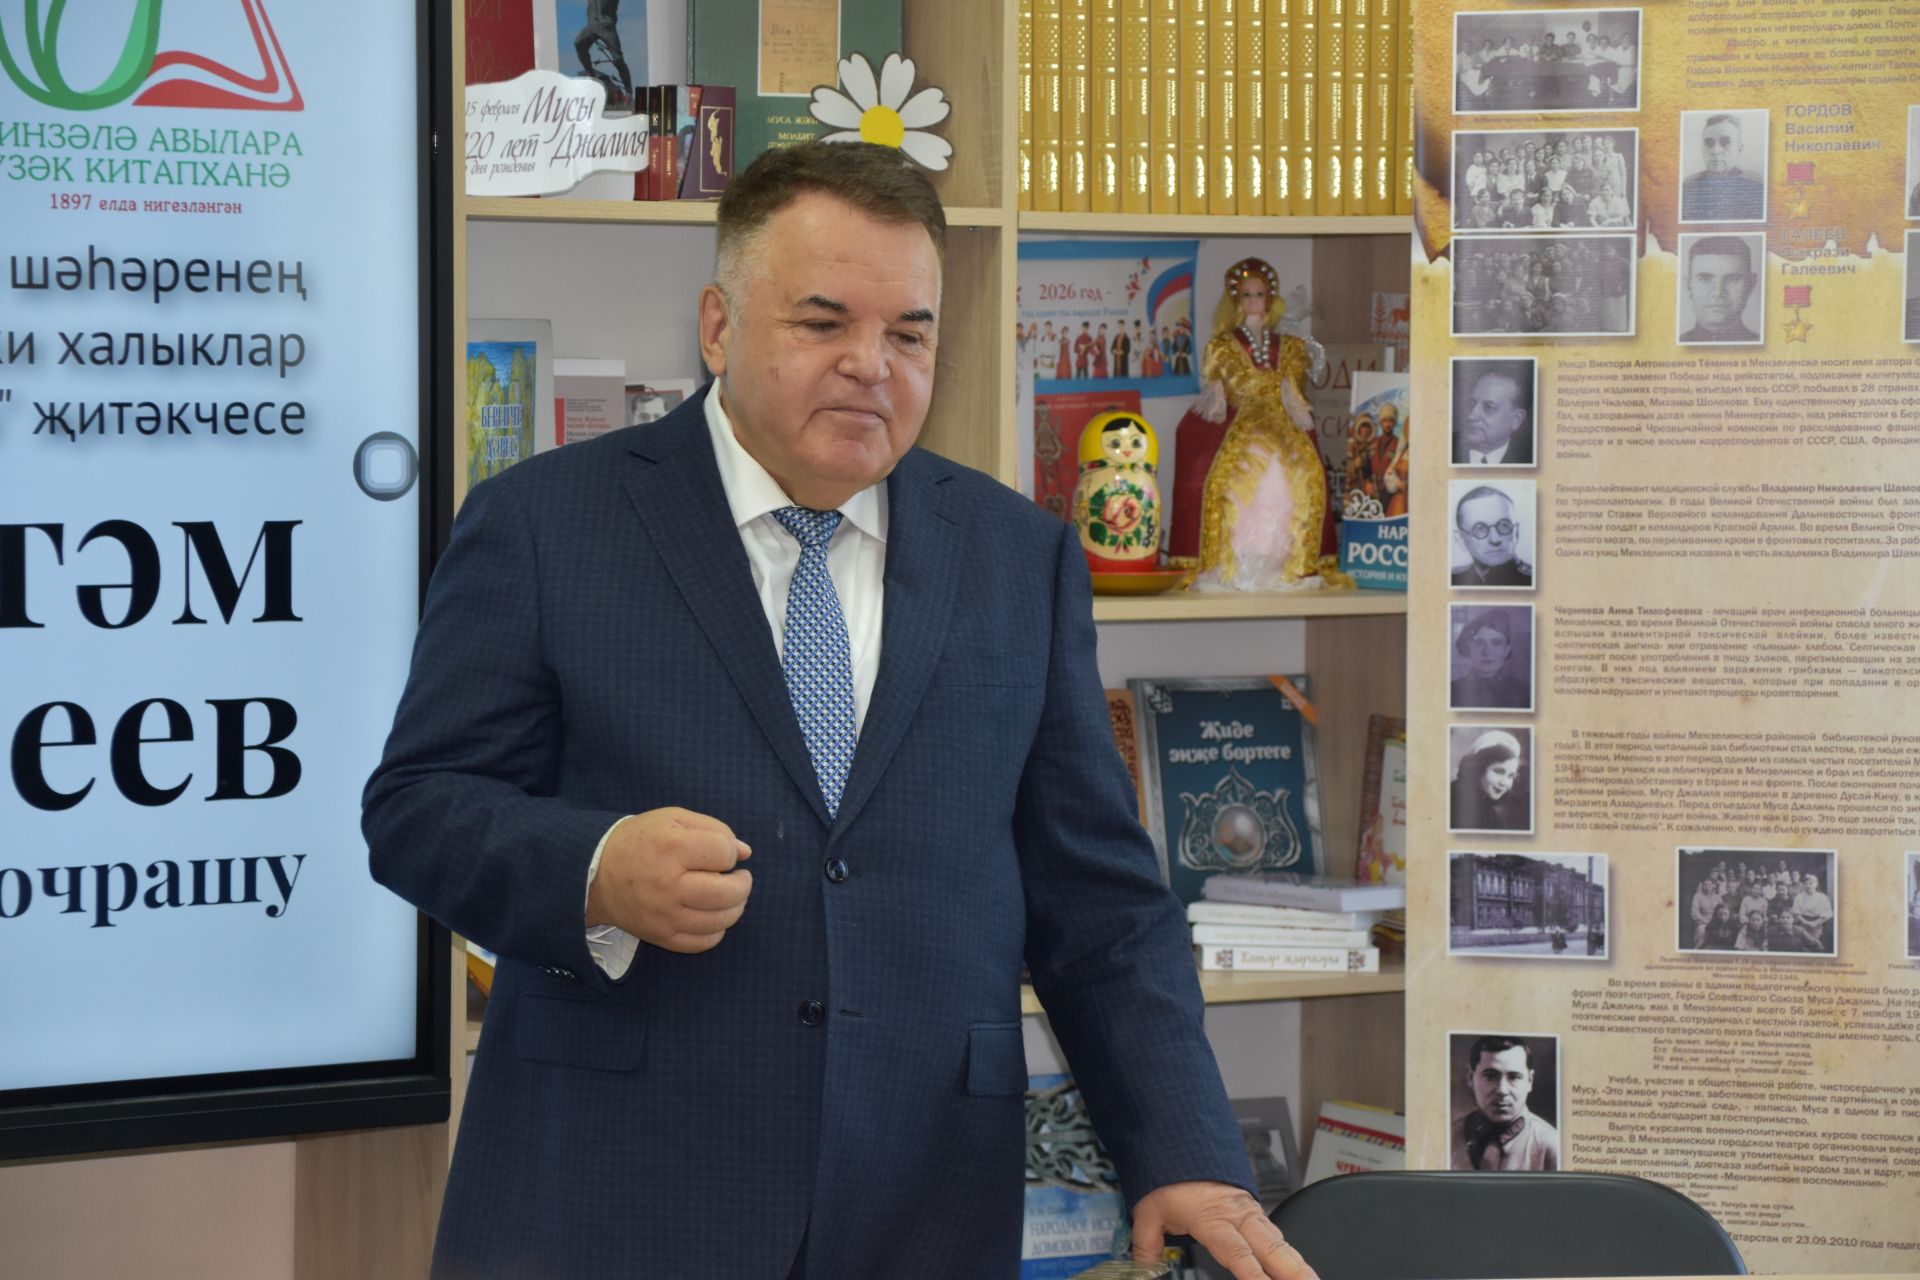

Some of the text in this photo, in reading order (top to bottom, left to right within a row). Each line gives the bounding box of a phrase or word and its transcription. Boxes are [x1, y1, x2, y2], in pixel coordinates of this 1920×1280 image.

[481, 99, 521, 122] февраля
[523, 86, 596, 144] Мусы
[1785, 104, 1852, 119] ГОРДОВ
[1785, 121, 1854, 135] Василий
[148, 127, 303, 156] АВЫЛАРА
[500, 134, 540, 160] лет
[549, 122, 649, 169] Джалиля
[1784, 139, 1881, 153] Николаевич
[85, 157, 290, 188] КИТАПХАНӘ
[489, 157, 536, 181] рождения
[50, 193, 242, 214] 1897 елда нигезләнгән
[10, 245, 307, 303] шәһәренең
[1782, 263, 1856, 275] Галеевич
[1039, 284, 1076, 301] 2026
[1079, 287, 1103, 302] год
[0, 331, 305, 377] и халыклар
[32, 400, 305, 443] җитәкчесе
[1347, 542, 1409, 567] РОСС
[1200, 720, 1255, 742] Җиде
[10, 697, 302, 811] еев
[0, 854, 307, 928] очрашу
